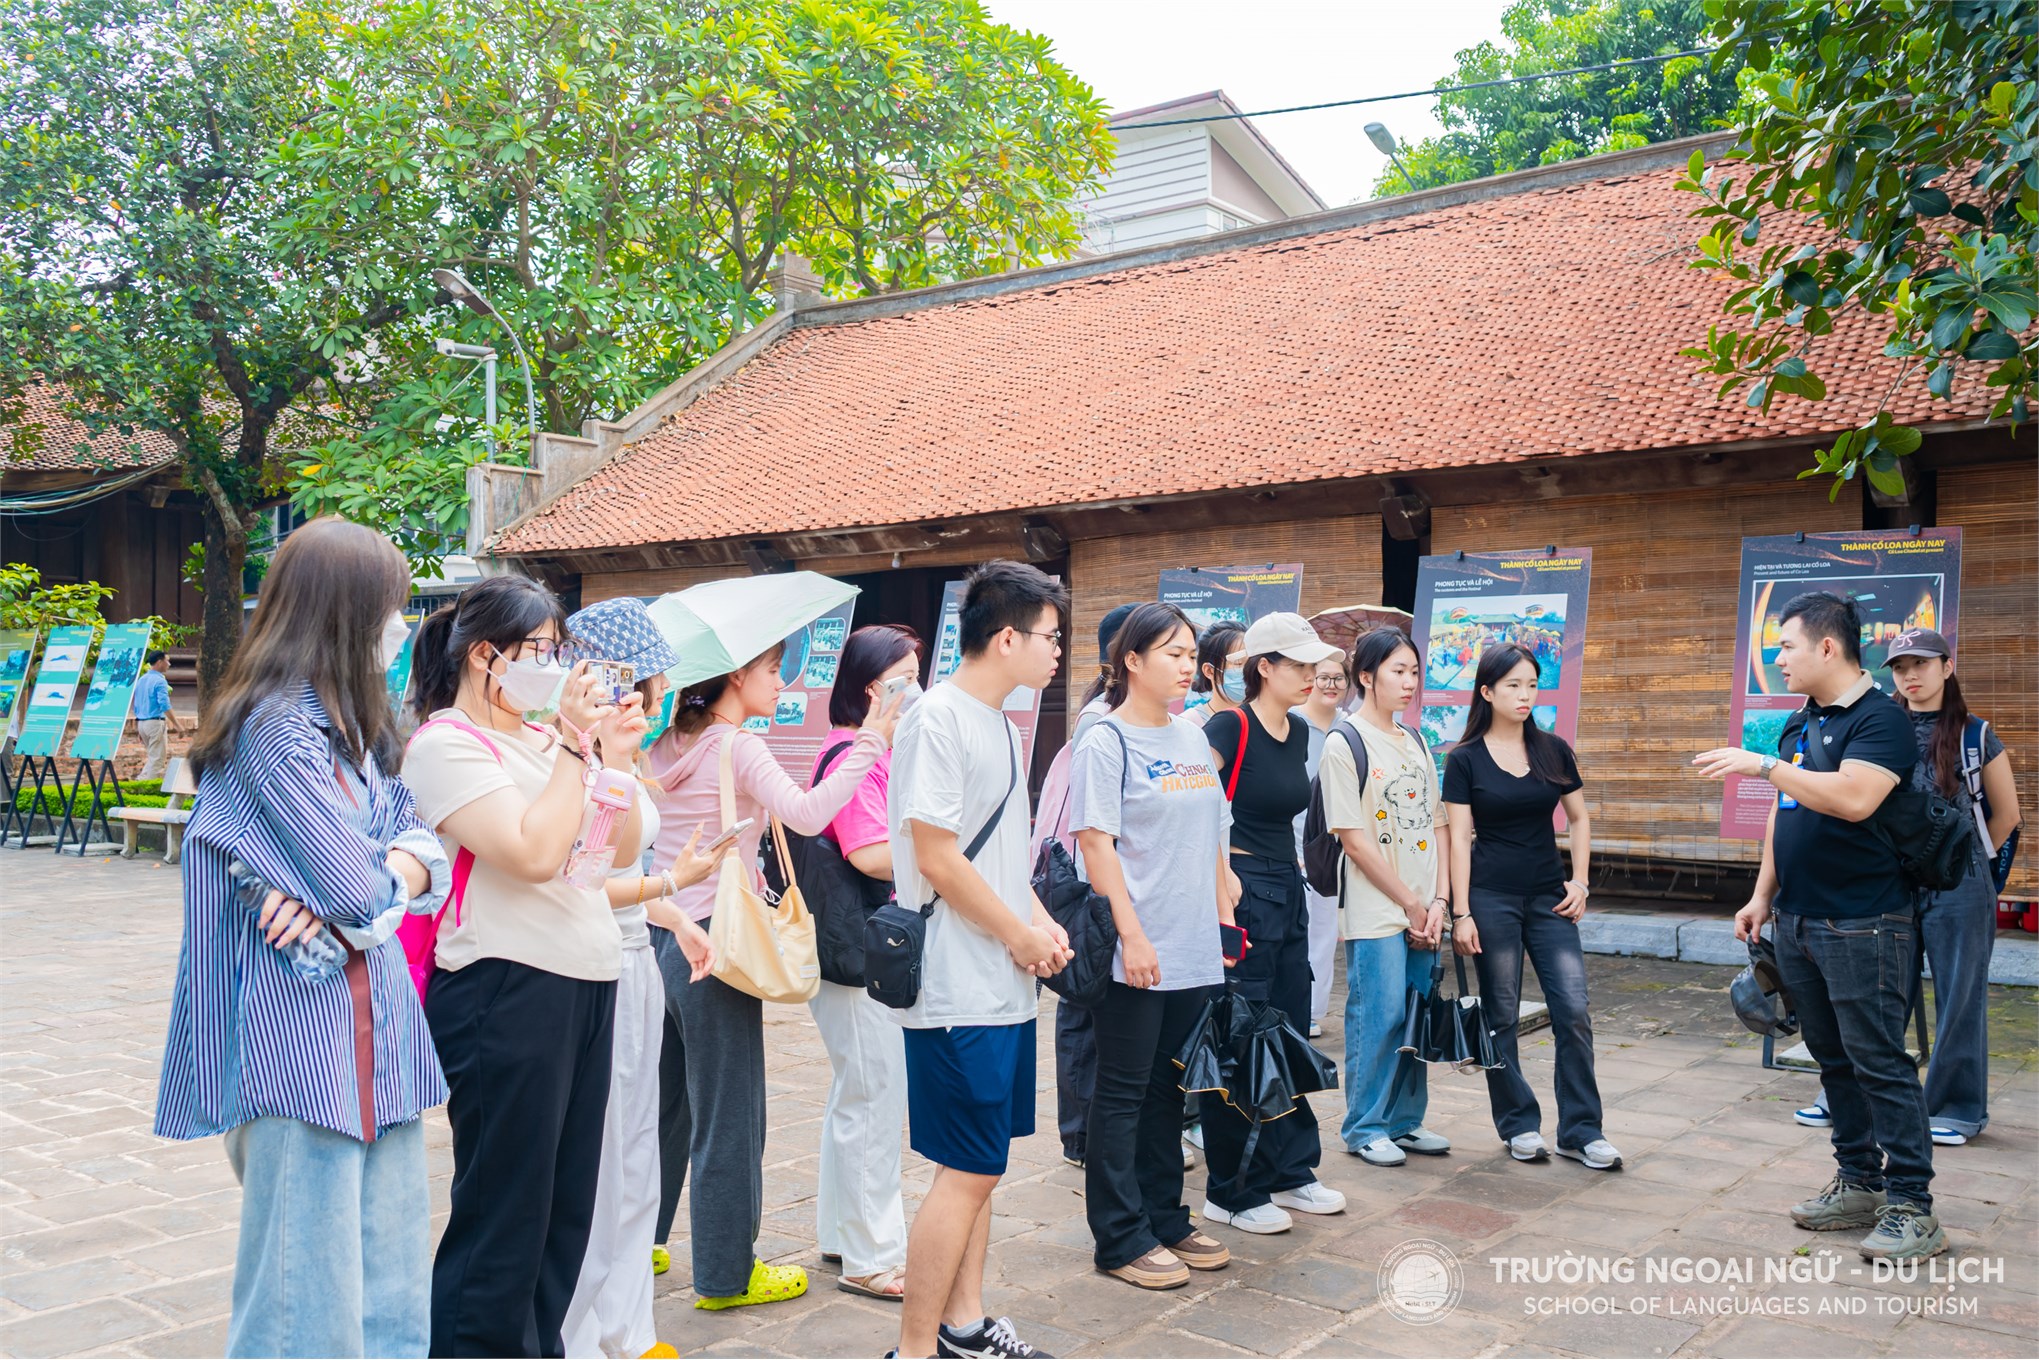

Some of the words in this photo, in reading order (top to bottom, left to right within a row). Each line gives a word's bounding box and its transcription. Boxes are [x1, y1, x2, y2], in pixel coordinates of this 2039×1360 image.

[1840, 542, 1871, 552] THÀNH
[1884, 541, 1902, 550] LOA
[1902, 539, 1926, 548] NGÀY
[1927, 540, 1946, 548] NAY
[1500, 561, 1524, 569] THÀNH
